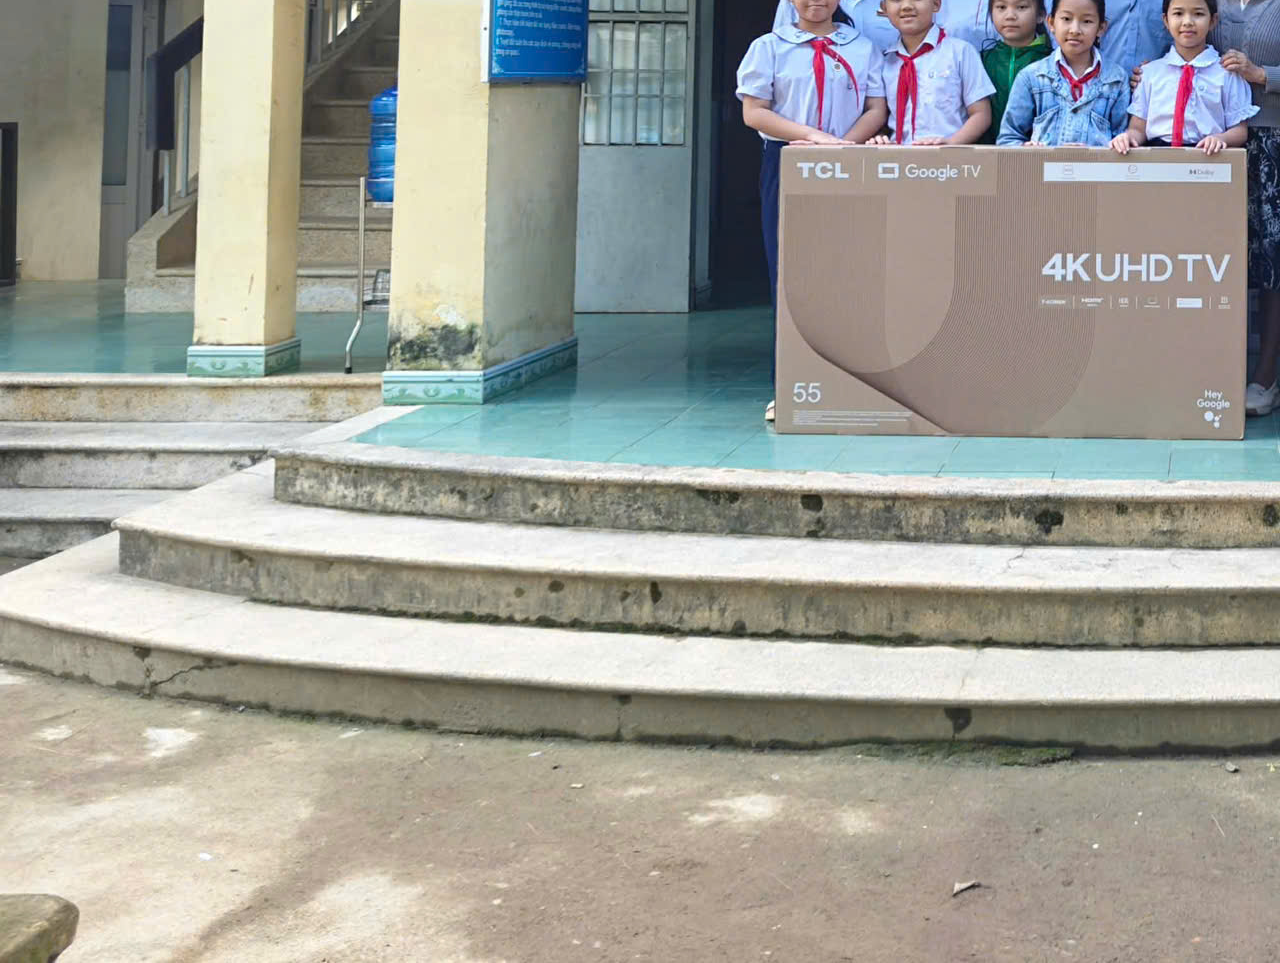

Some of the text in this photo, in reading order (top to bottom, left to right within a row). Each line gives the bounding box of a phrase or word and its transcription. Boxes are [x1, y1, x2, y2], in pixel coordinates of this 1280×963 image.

[797, 161, 849, 179] TCL
[905, 163, 982, 182] Google TV
[1042, 253, 1231, 283] 4K UHD TV
[793, 382, 821, 403] 55
[1204, 389, 1223, 401] Hey
[1196, 398, 1230, 410] Google
